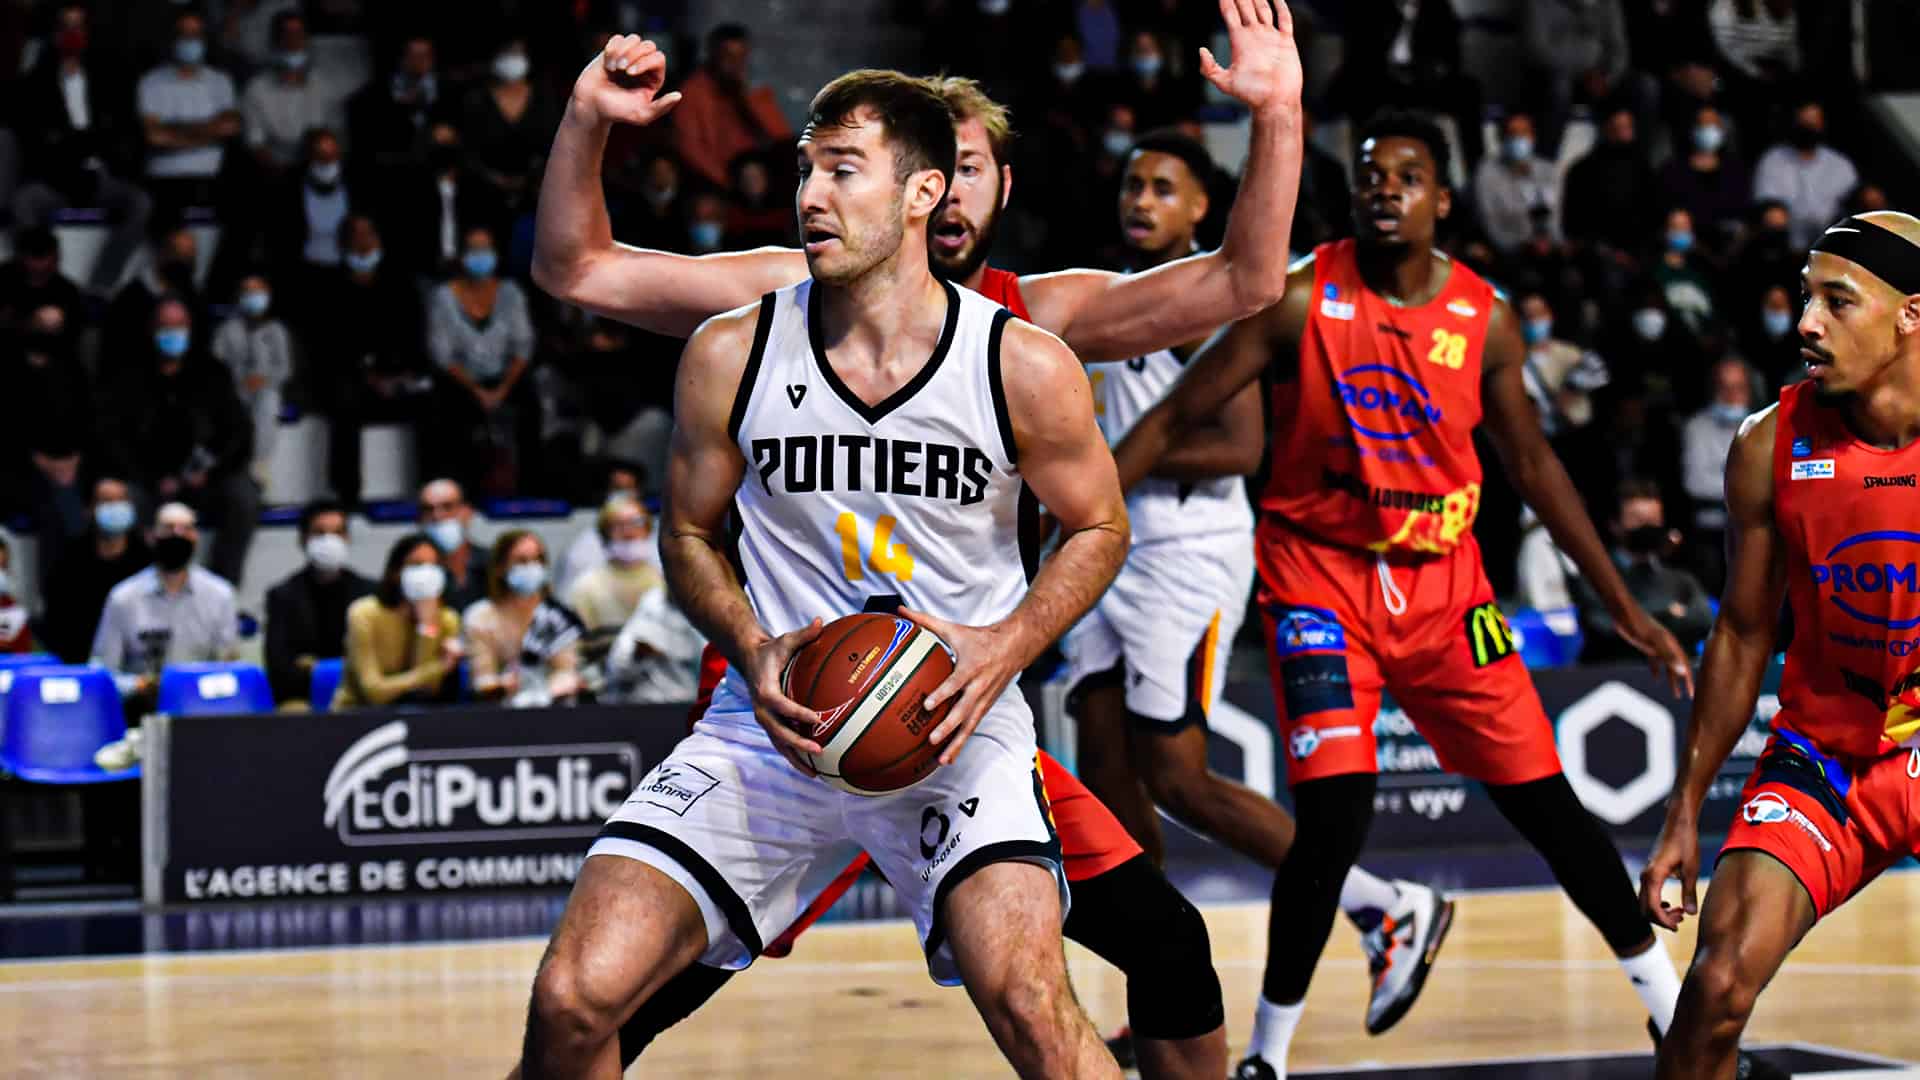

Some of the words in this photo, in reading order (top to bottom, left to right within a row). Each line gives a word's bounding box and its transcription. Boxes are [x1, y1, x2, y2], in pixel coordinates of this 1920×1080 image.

[1427, 328, 1467, 370] 28
[751, 434, 993, 506] POITIERS
[1863, 473, 1917, 489] SPALDING
[834, 511, 914, 582] 14
[1810, 562, 1920, 593] PROM
[353, 757, 626, 830] EdiPublic
[184, 862, 349, 899] L'AGENCE
[359, 860, 405, 891] DE
[415, 853, 586, 889] COMMUN
